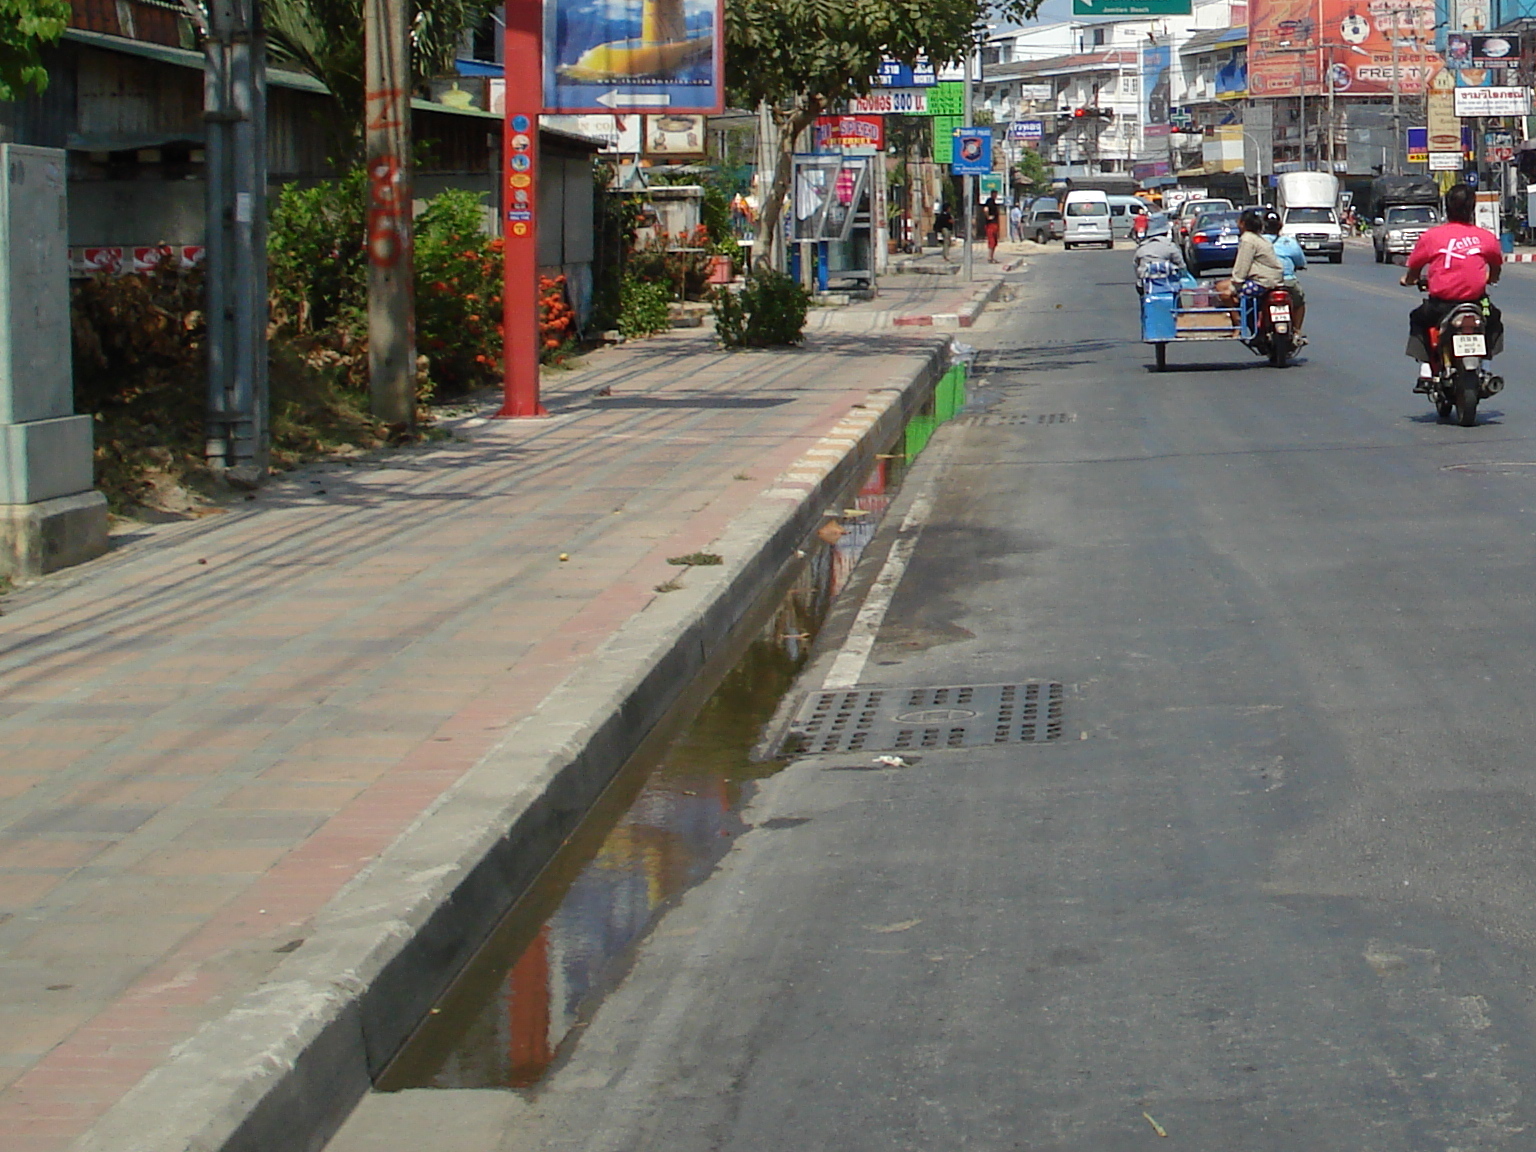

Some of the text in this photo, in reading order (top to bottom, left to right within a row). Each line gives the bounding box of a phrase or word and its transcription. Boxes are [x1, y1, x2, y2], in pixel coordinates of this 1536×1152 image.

[1359, 68, 1431, 78] FREE TV
[894, 93, 912, 110] 300
